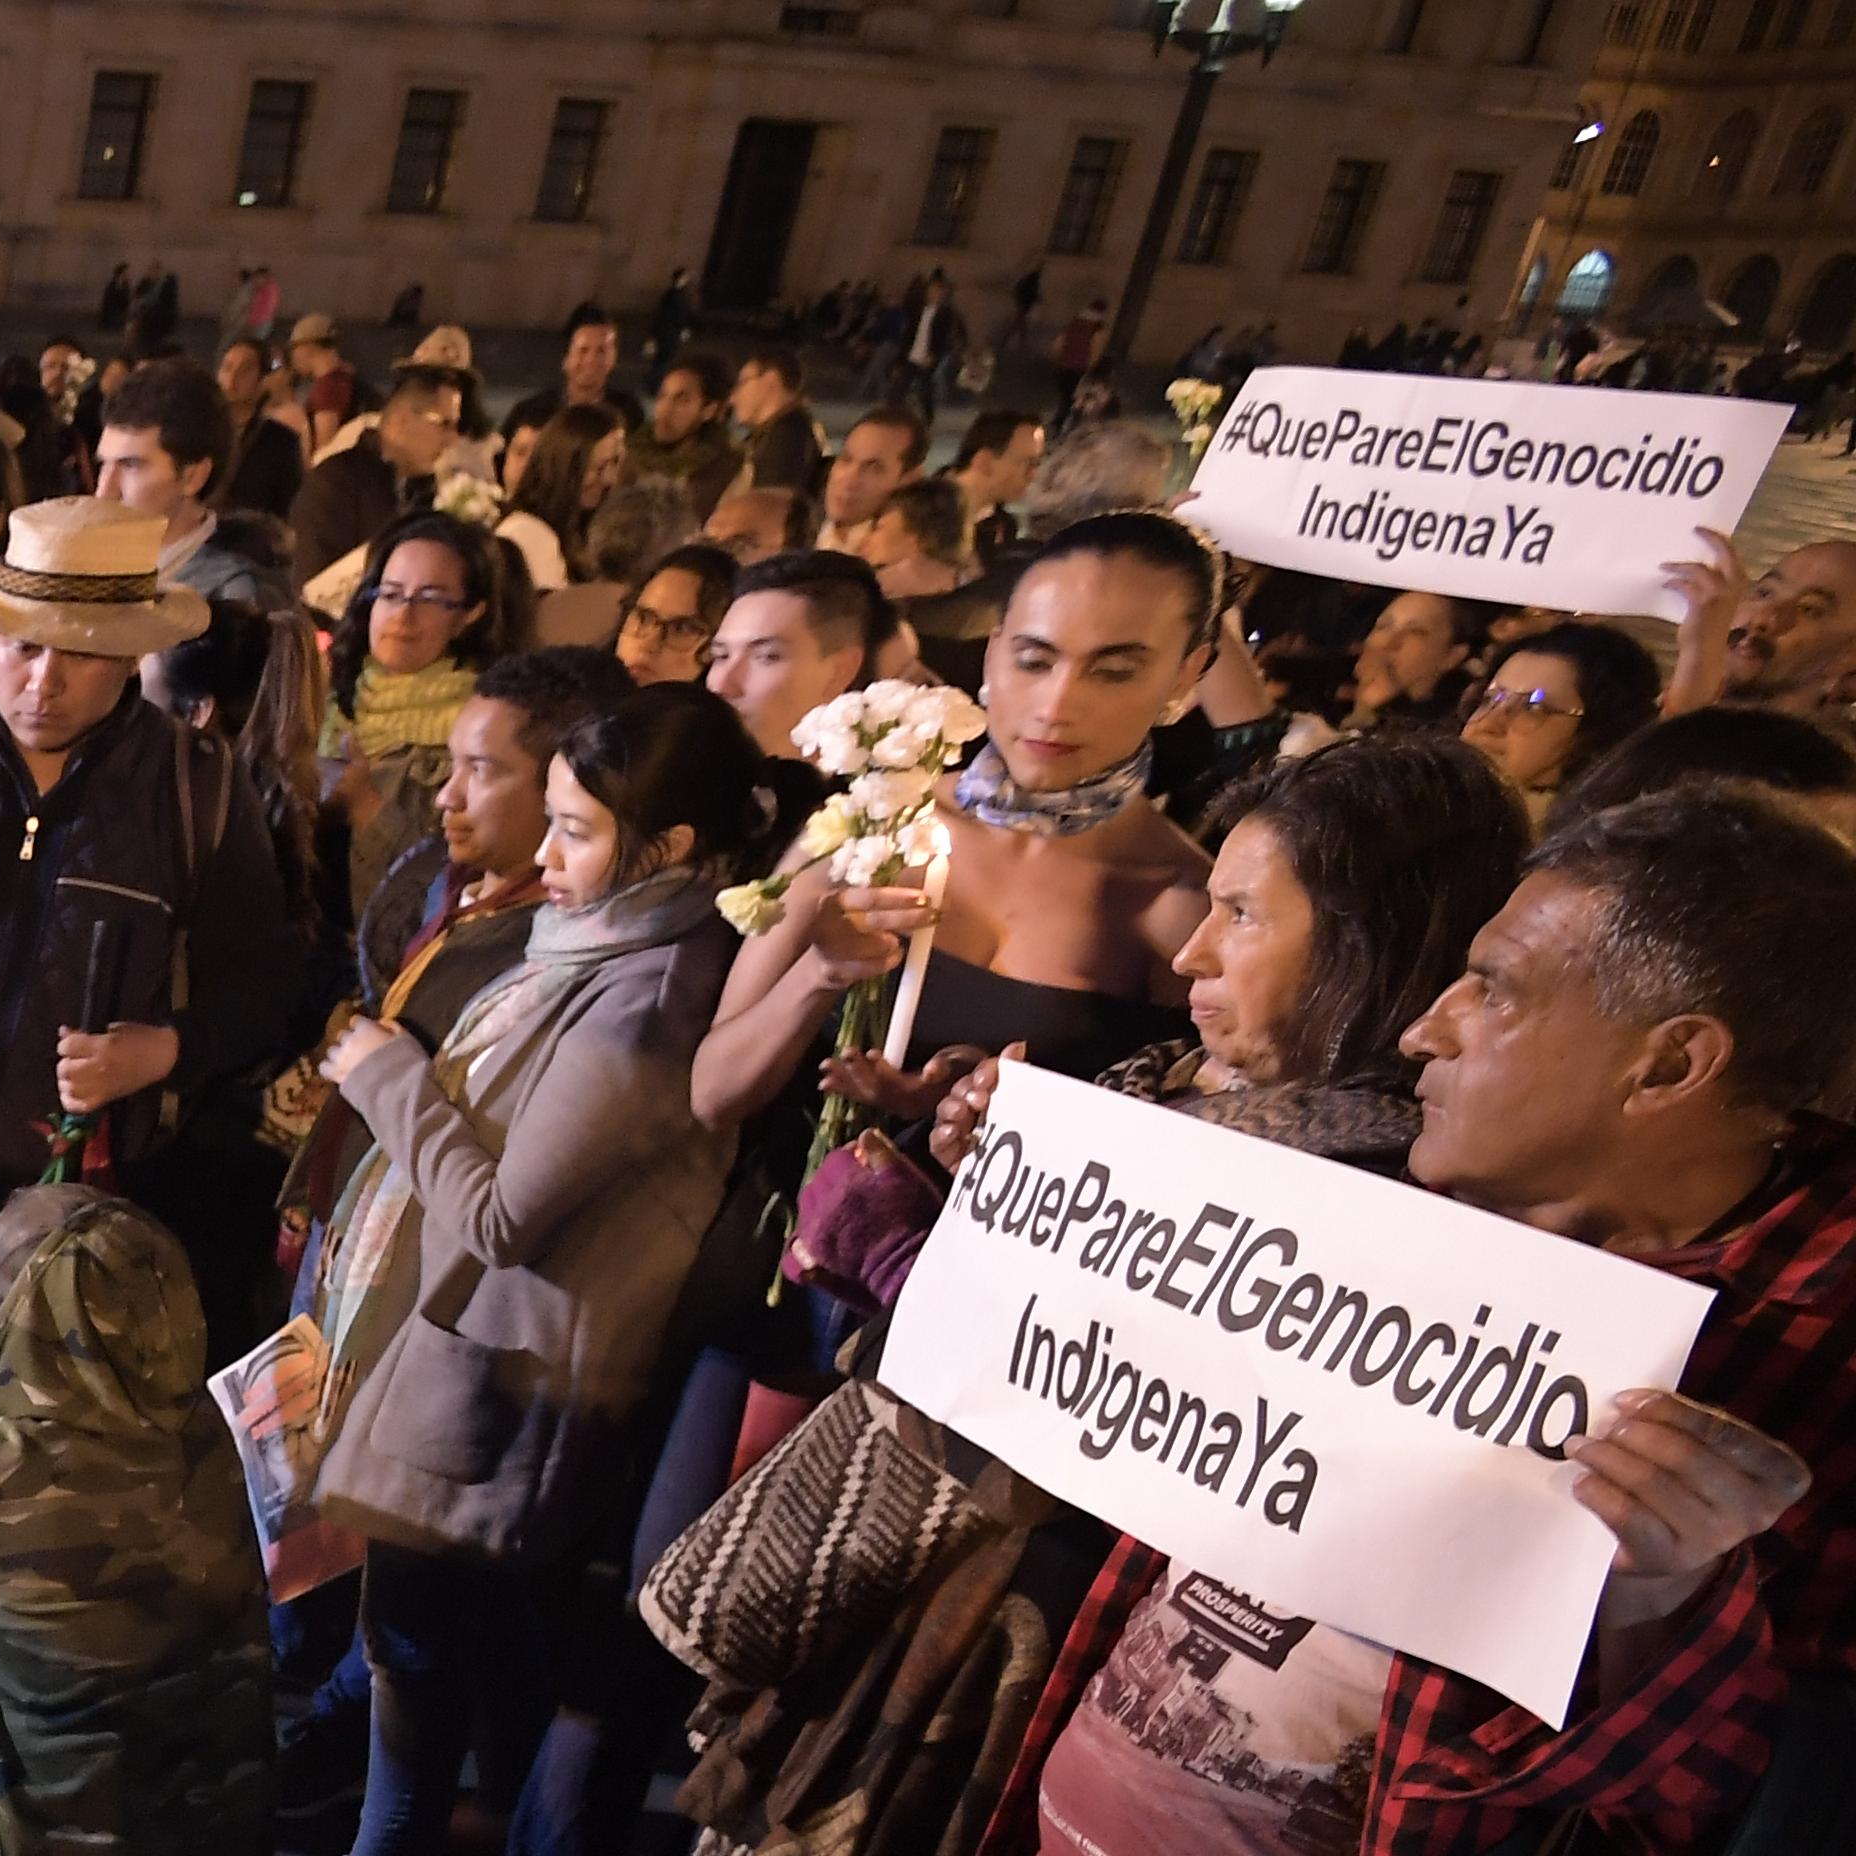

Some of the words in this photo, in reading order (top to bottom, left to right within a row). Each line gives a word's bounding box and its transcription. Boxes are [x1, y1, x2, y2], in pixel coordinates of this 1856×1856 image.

[1219, 400, 1725, 499] #QuePareElGenocidio
[1297, 484, 1556, 565] IndigenaYa
[953, 1123, 1590, 1462] #QuePareElGenocidio
[1008, 1294, 1319, 1535] IndigenaYa
[1187, 1578, 1285, 1641] PROSPERITY
